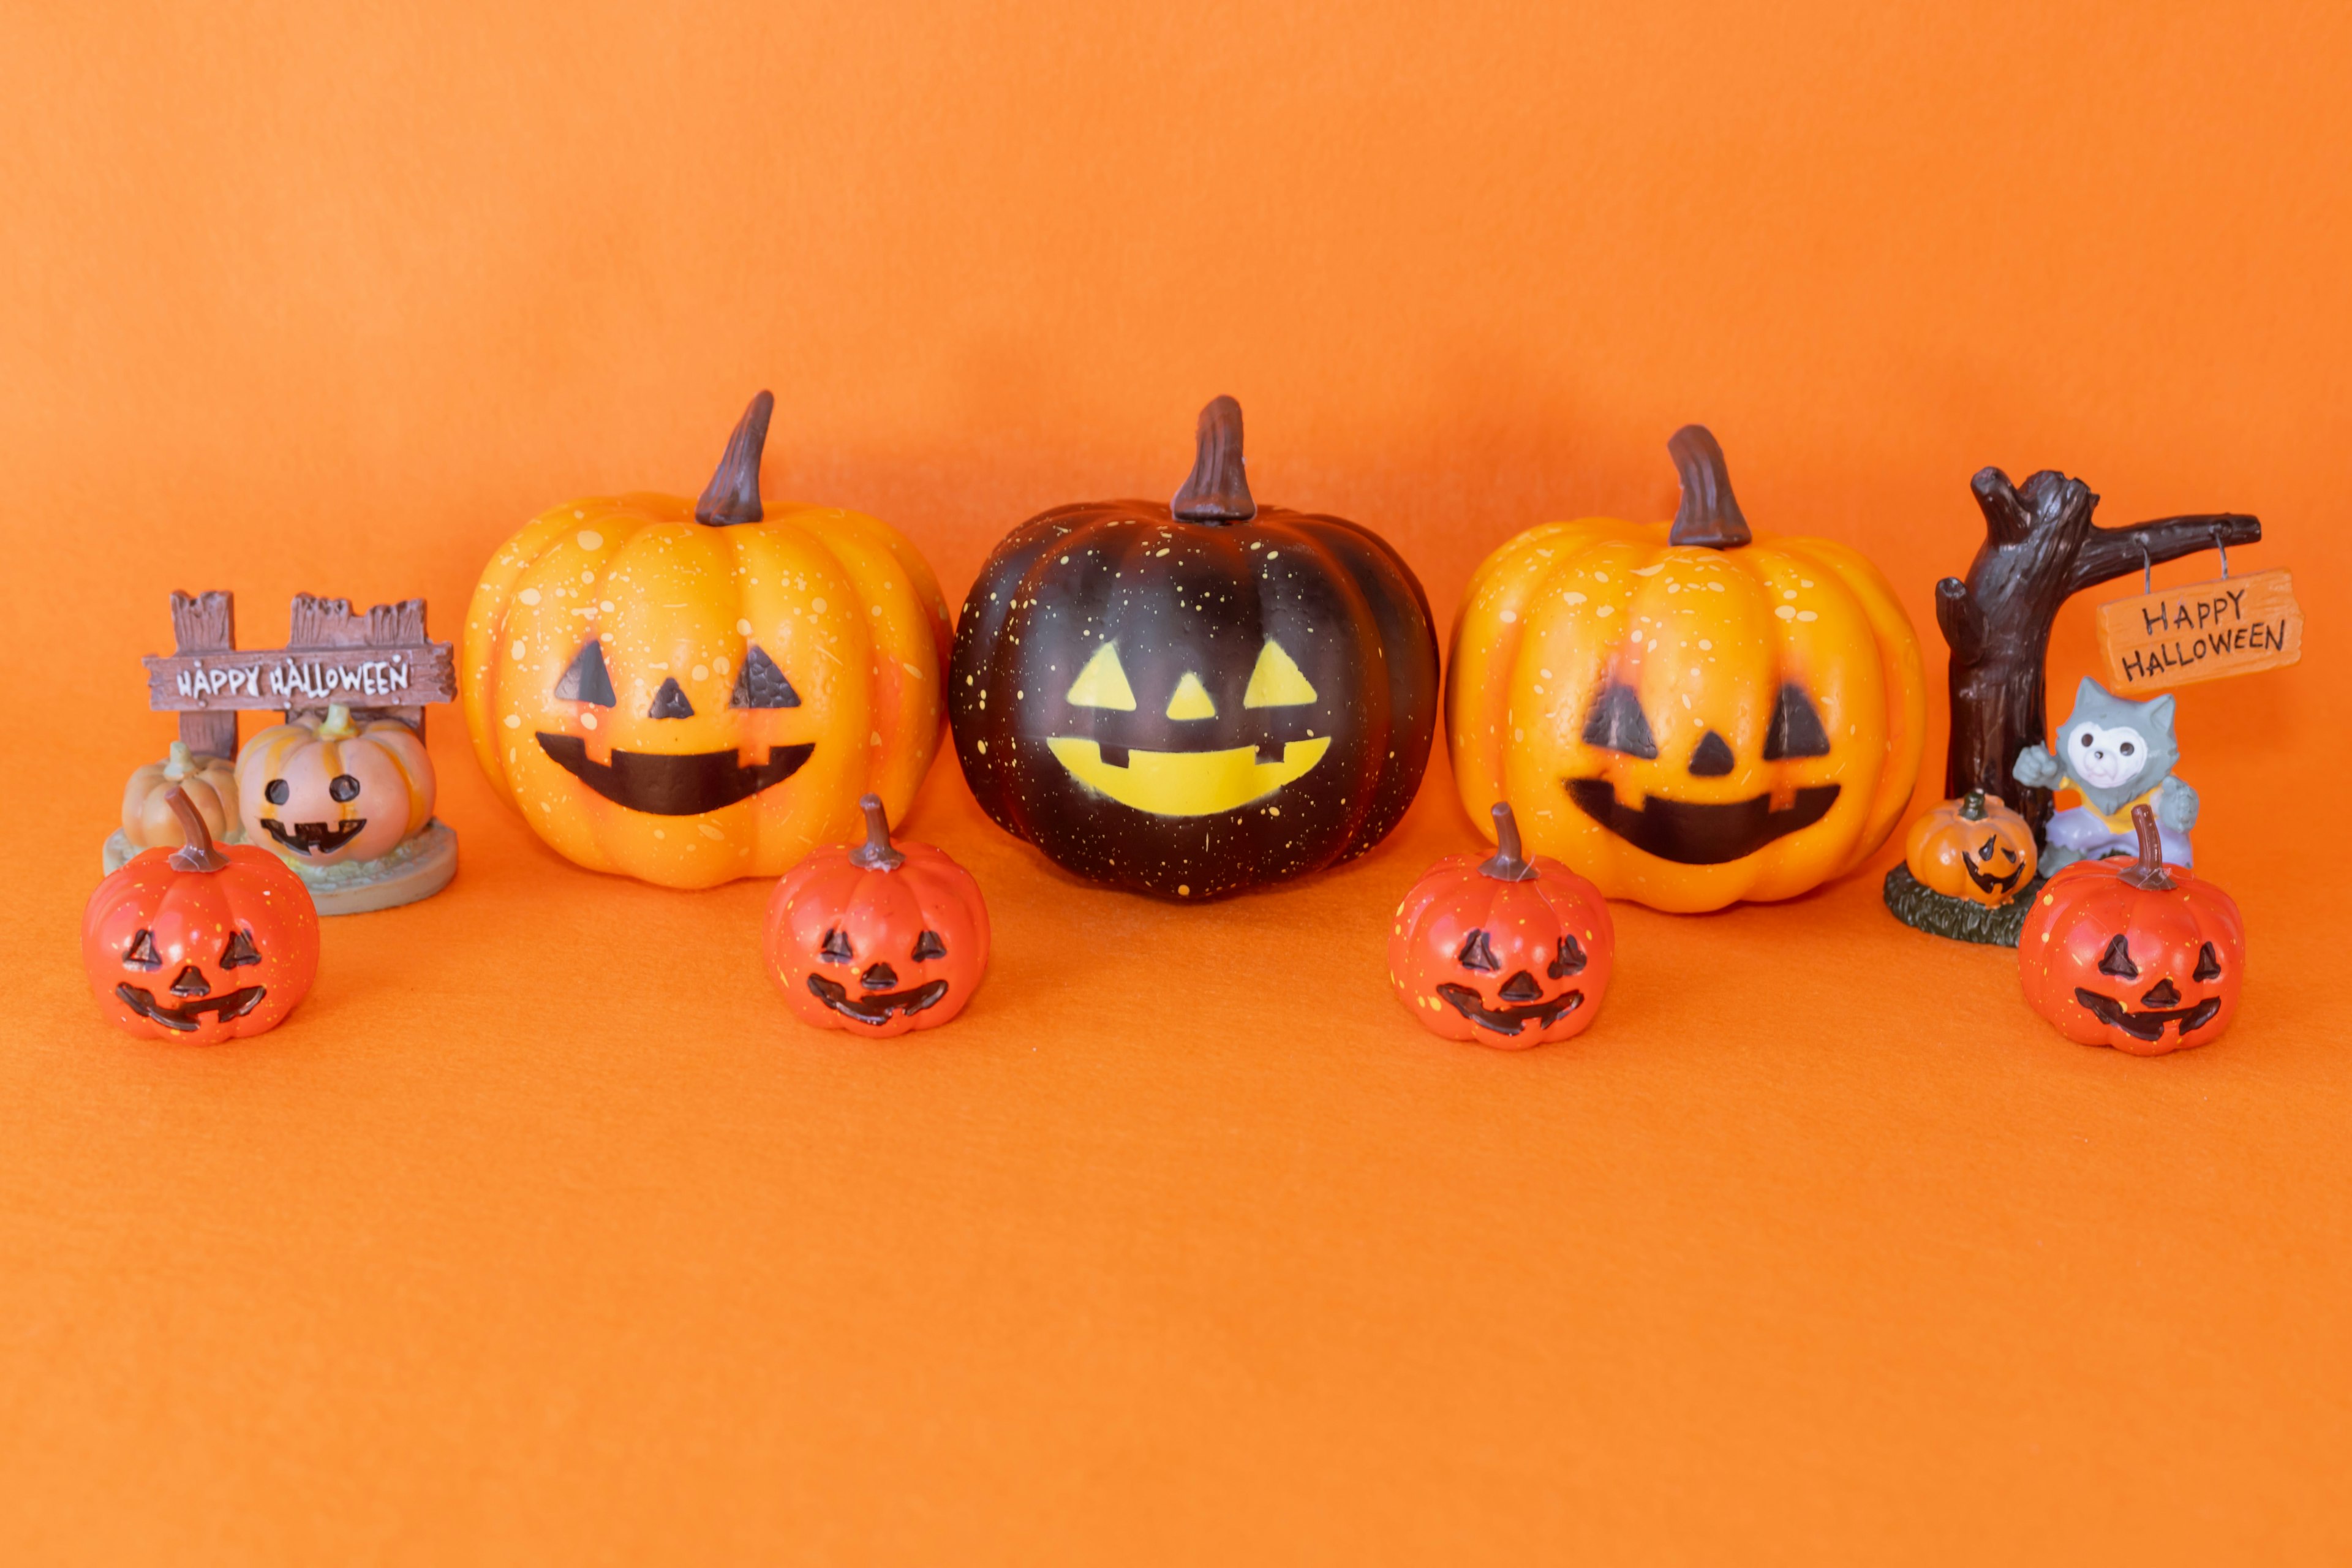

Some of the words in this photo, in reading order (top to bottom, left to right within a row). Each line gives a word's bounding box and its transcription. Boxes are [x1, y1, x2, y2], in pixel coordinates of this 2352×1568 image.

[2143, 589, 2244, 636] HAPPY
[2122, 619, 2285, 682] HALLOWEEN
[177, 665, 260, 698] HAPPY
[270, 662, 408, 698] HALLOWEEN
